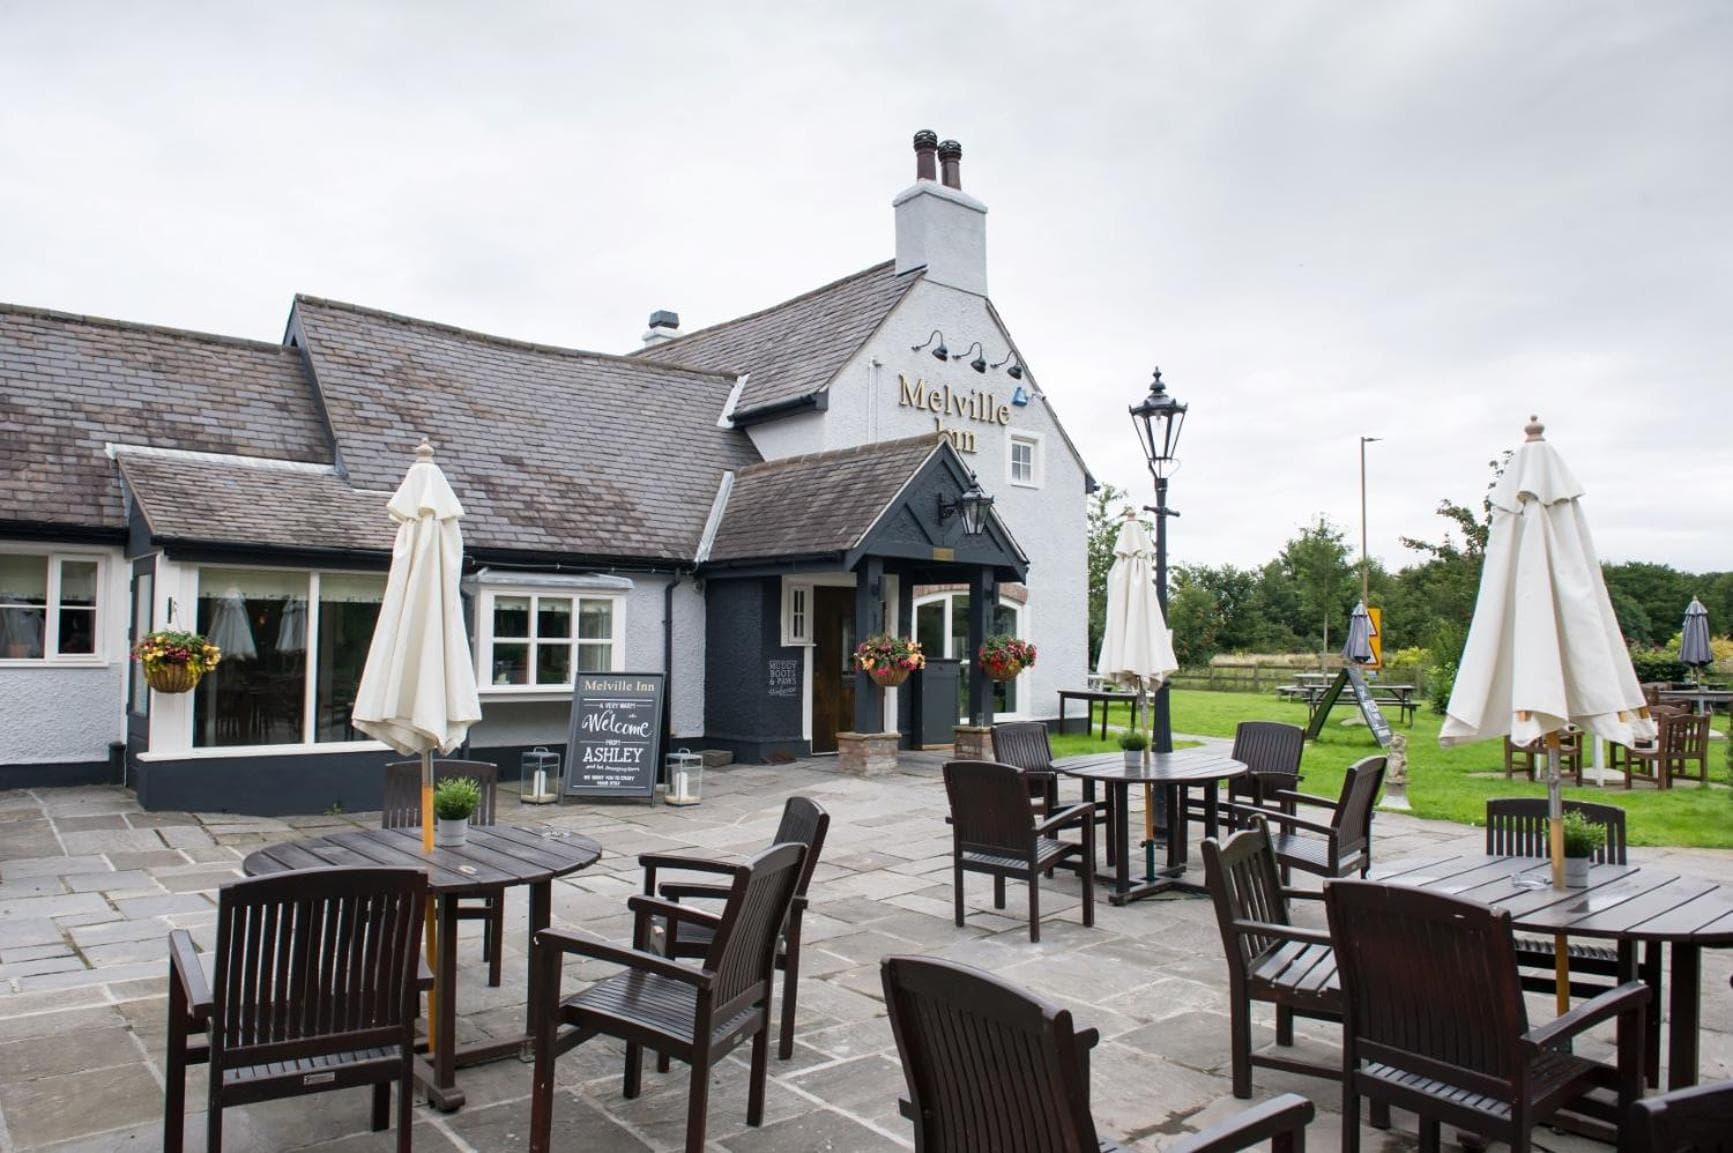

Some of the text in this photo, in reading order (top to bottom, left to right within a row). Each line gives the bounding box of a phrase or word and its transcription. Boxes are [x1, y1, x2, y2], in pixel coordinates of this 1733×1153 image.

[899, 371, 1010, 425] Melville
[584, 680, 655, 692] Melville Inn
[582, 709, 653, 737] Welcome
[582, 746, 644, 763] ASHLEY
